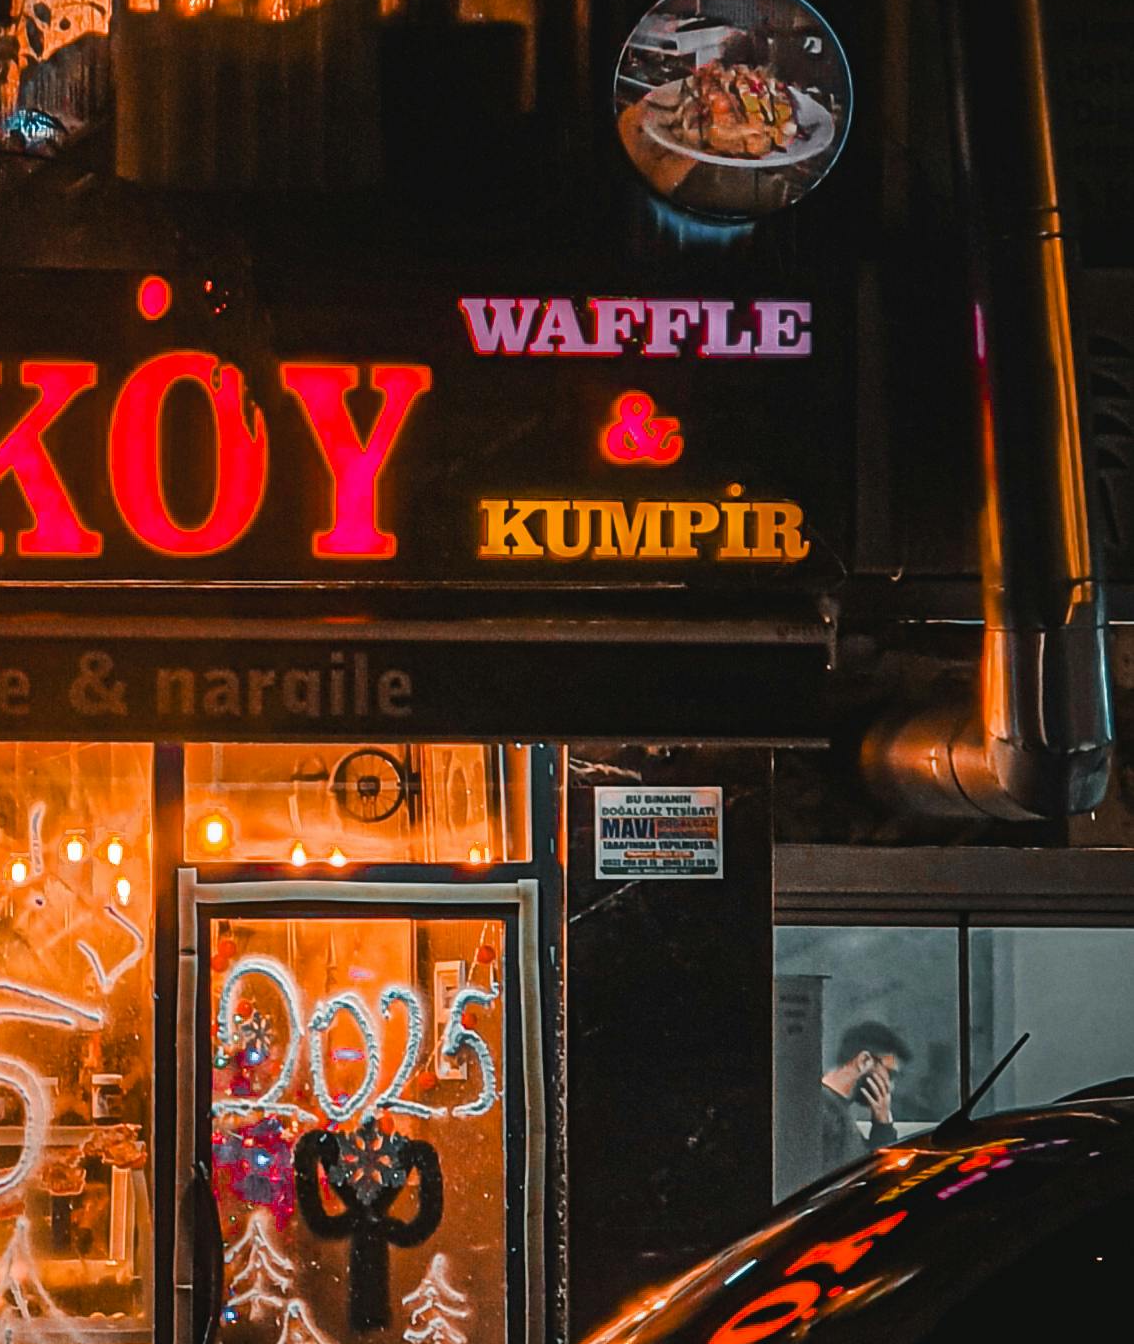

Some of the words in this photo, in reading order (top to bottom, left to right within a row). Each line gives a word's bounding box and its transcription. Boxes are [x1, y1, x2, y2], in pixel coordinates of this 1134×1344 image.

[459, 296, 814, 358] WAFFLE
[600, 390, 683, 465] &
[479, 482, 811, 562] KUMPİR
[67, 650, 129, 716] &
[602, 806, 662, 816] DOĞALGAZ
[210, 955, 502, 1123] 2025
